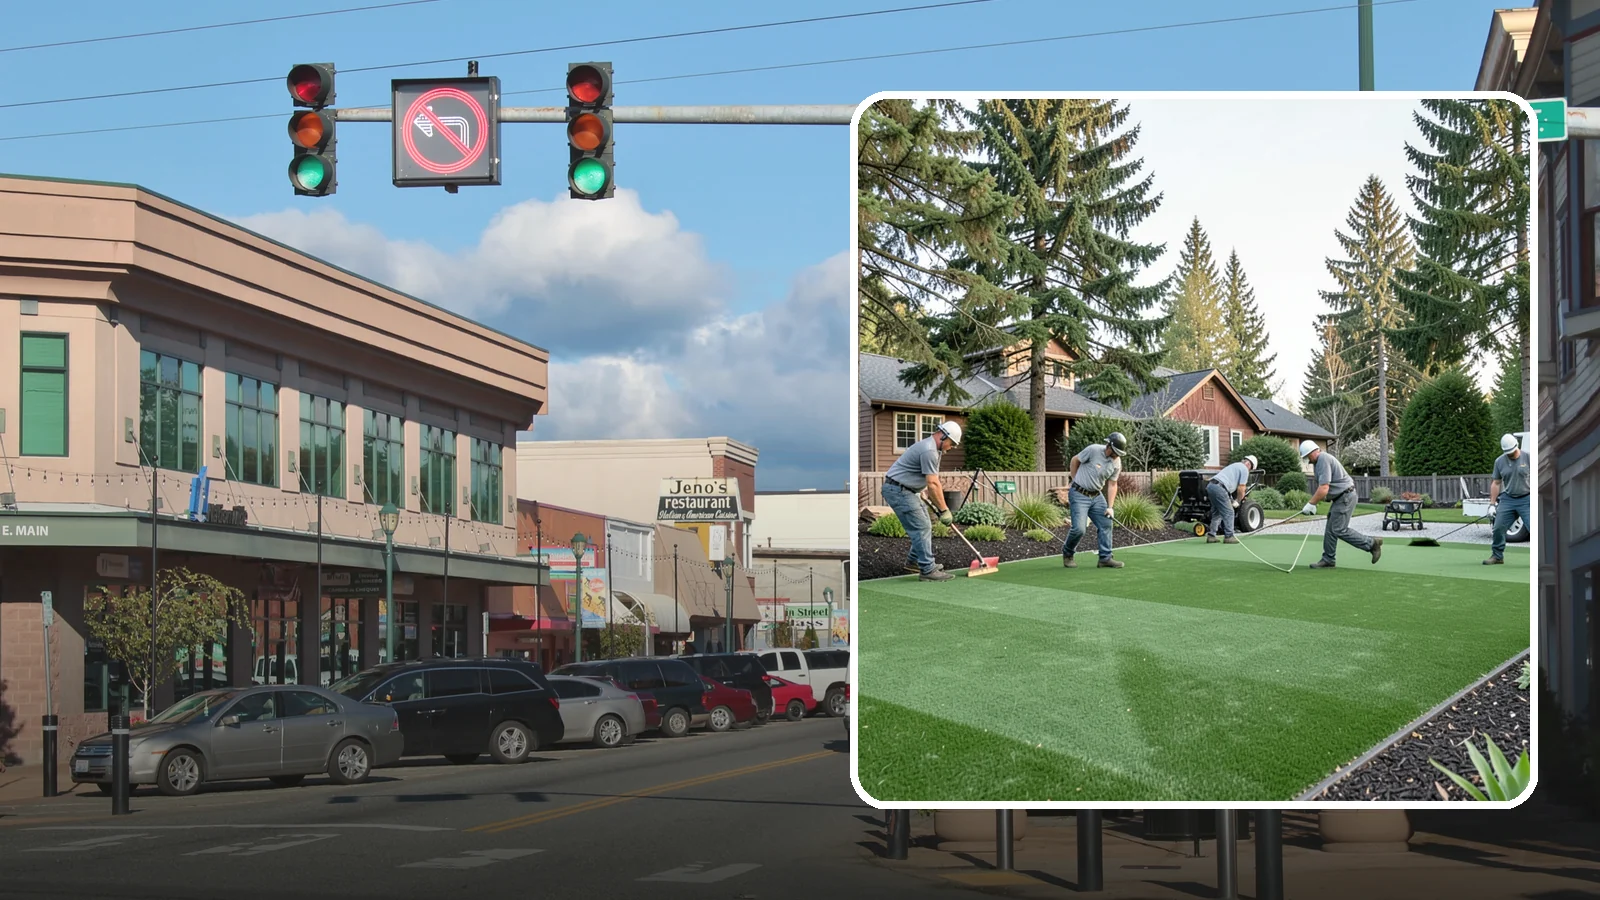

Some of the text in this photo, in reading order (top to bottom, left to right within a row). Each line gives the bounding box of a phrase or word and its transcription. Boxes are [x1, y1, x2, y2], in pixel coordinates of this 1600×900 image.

[670, 480, 727, 494] Jeno's
[665, 496, 731, 509] restaurant
[658, 510, 681, 519] Italian
[686, 510, 714, 519] American
[715, 509, 737, 519] Cuisine
[2, 525, 49, 536] E. MAIN
[797, 607, 829, 617] Street
